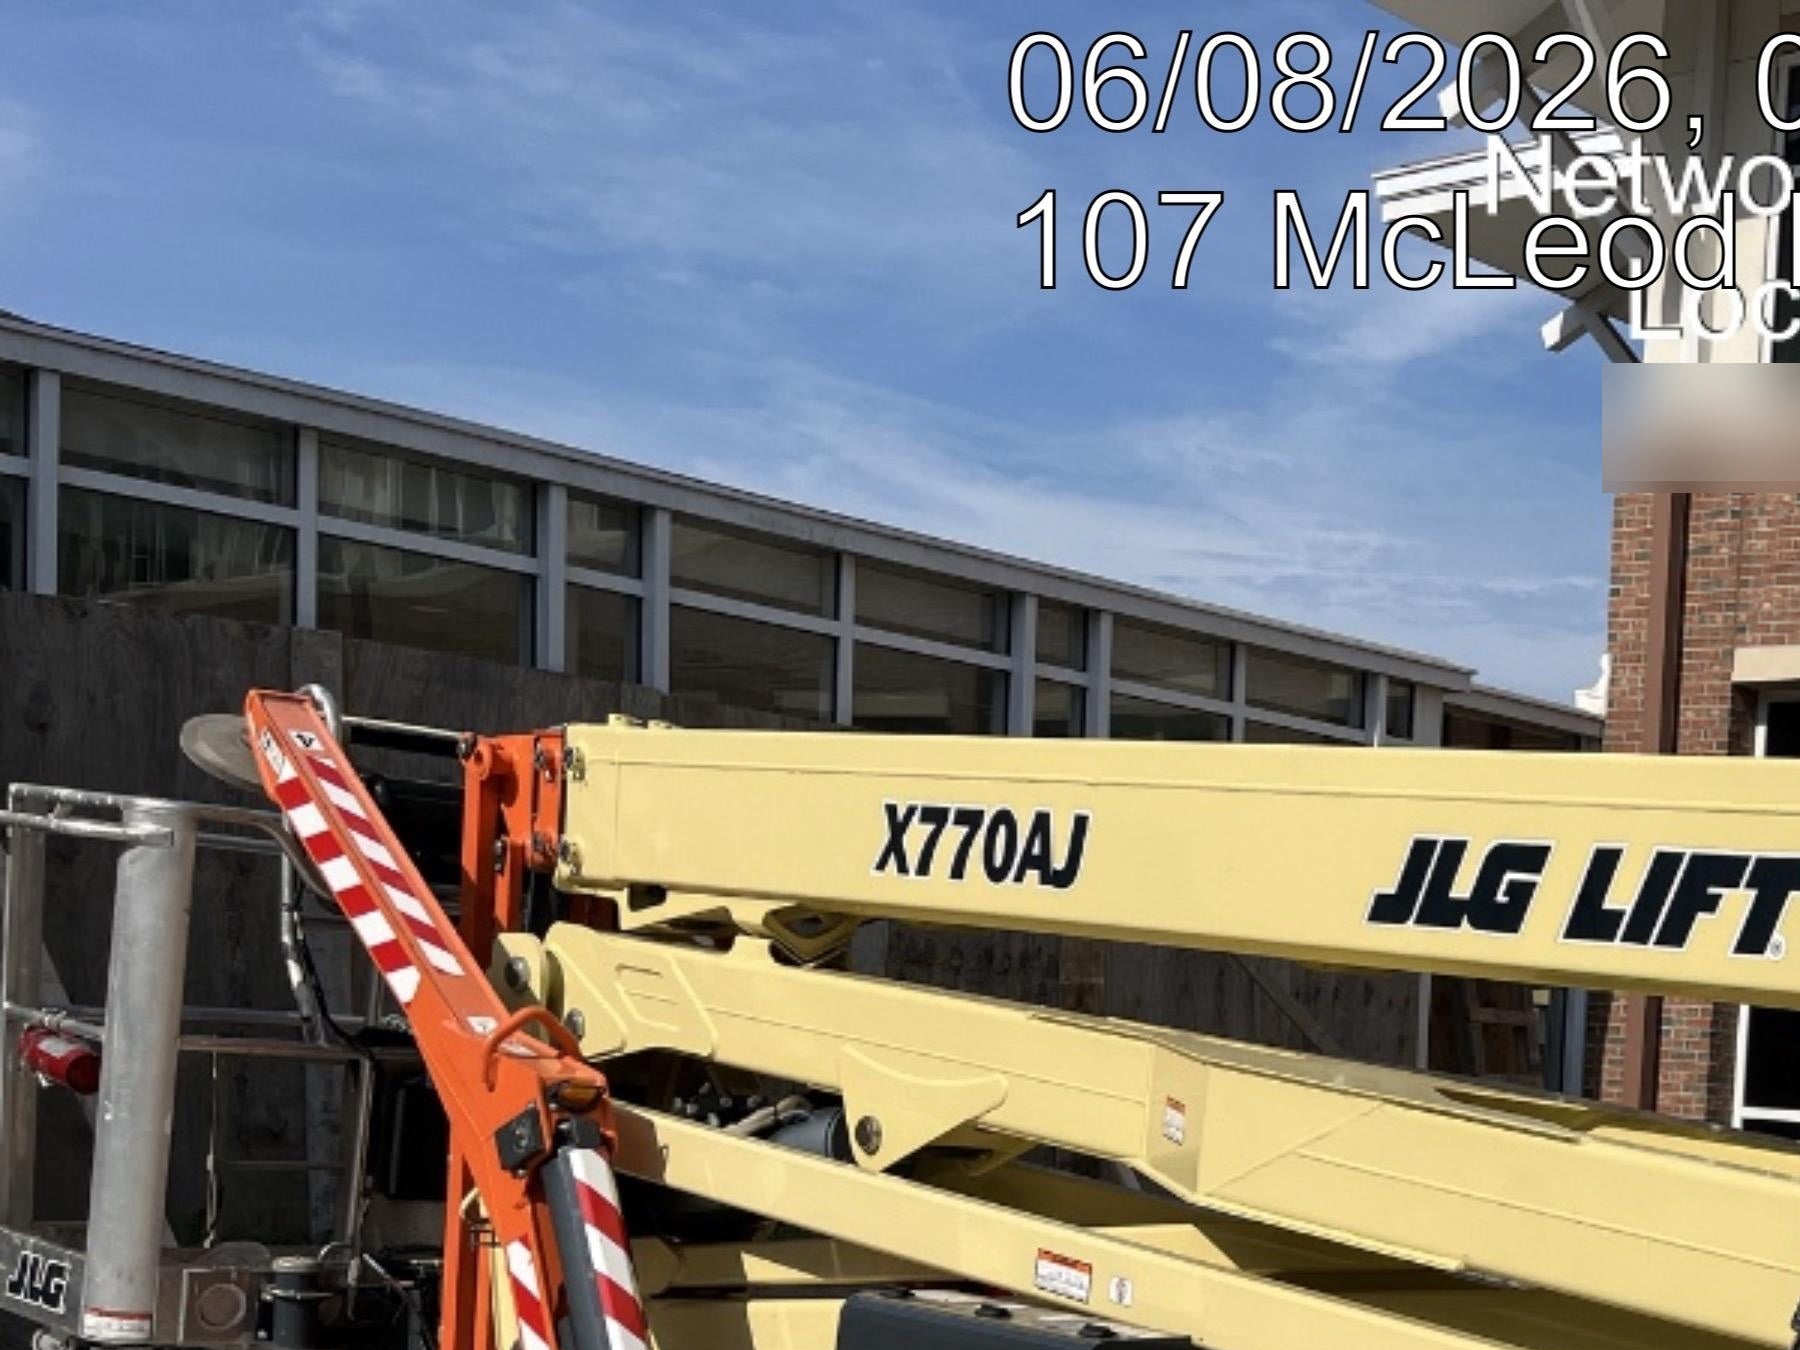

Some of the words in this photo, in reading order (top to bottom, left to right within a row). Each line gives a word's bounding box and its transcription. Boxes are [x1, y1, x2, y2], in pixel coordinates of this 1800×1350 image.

[873, 801, 1090, 889] X770AJ
[1365, 836, 1555, 936] JLG
[6, 1250, 71, 1314] JLG
